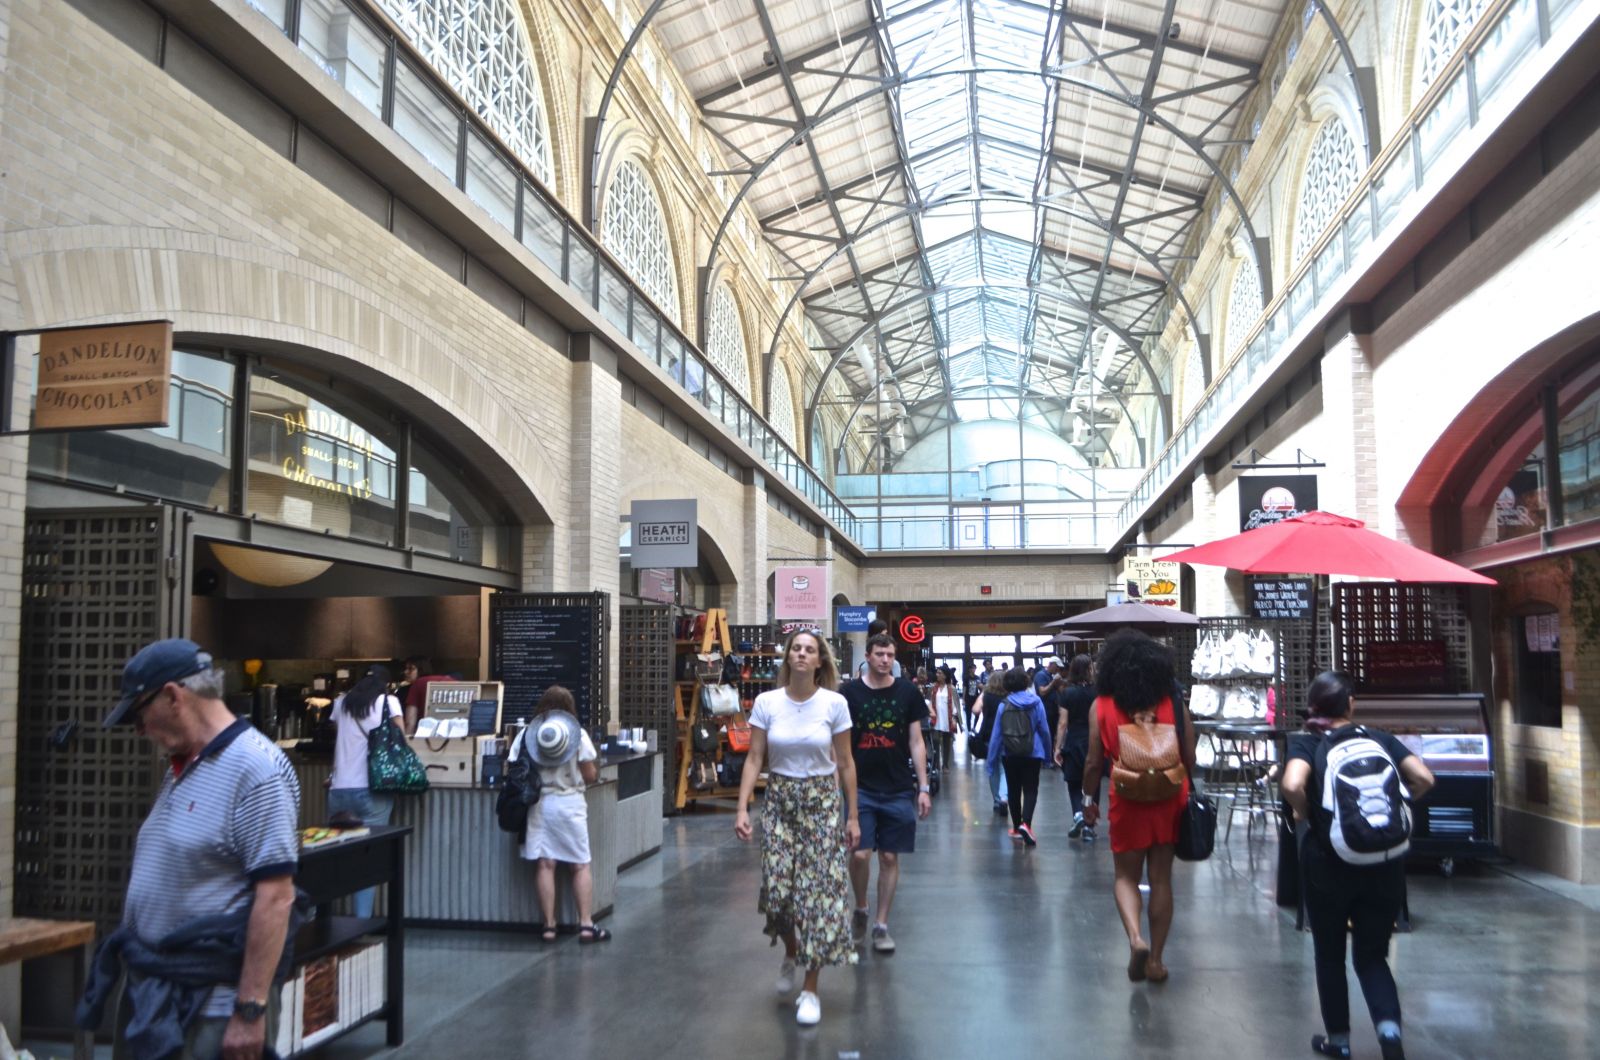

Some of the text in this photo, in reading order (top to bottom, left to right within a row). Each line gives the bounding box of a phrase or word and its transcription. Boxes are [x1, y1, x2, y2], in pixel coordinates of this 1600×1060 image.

[44, 342, 160, 372] DANDELION
[63, 370, 138, 381] SMALL-BATCH
[42, 379, 158, 411] CHOCOLATE
[642, 525, 686, 536] HEATH
[1128, 559, 1150, 568] Farm
[1136, 569, 1169, 578] To You
[900, 615, 925, 643] G
